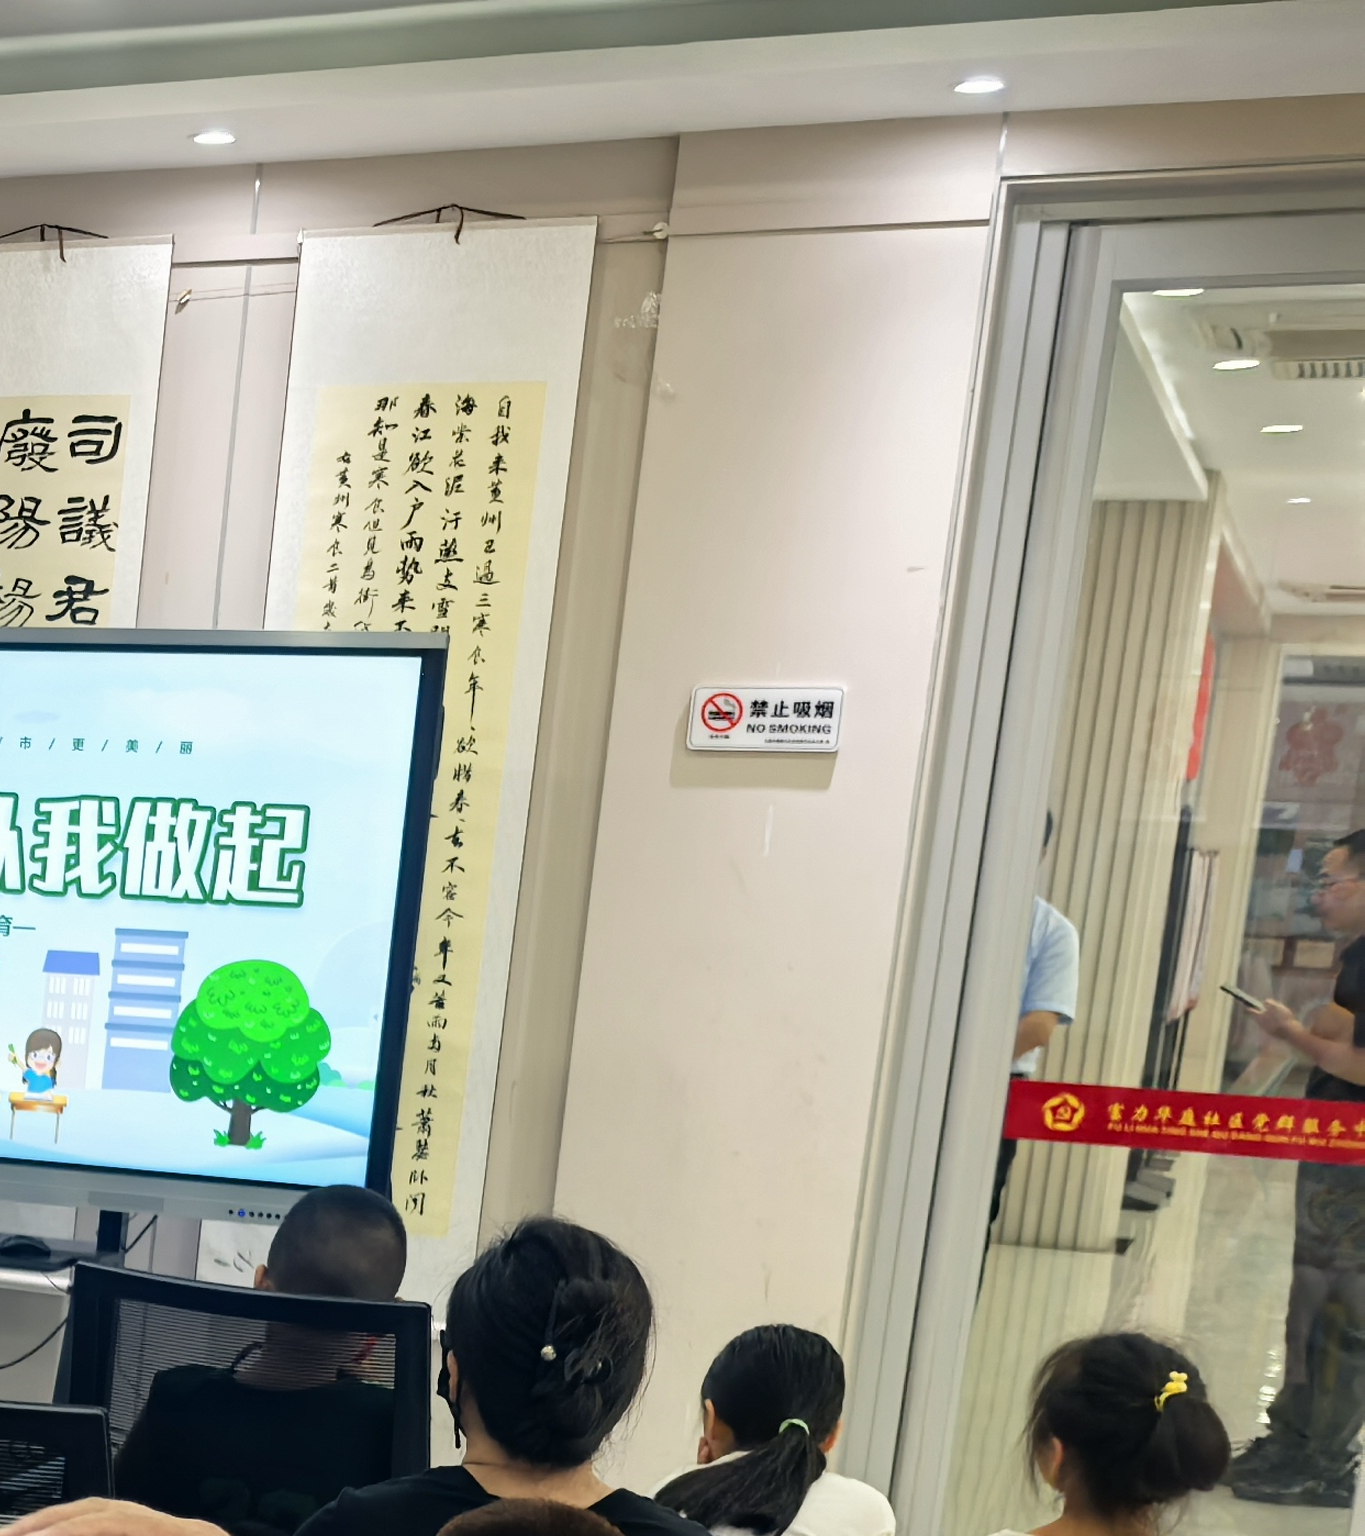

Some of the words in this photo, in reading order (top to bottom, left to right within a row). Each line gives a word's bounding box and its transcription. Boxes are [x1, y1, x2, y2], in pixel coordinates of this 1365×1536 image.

[749, 699, 835, 719] 禁止吸烟
[746, 723, 766, 733] NO
[769, 724, 832, 735] SMOKING
